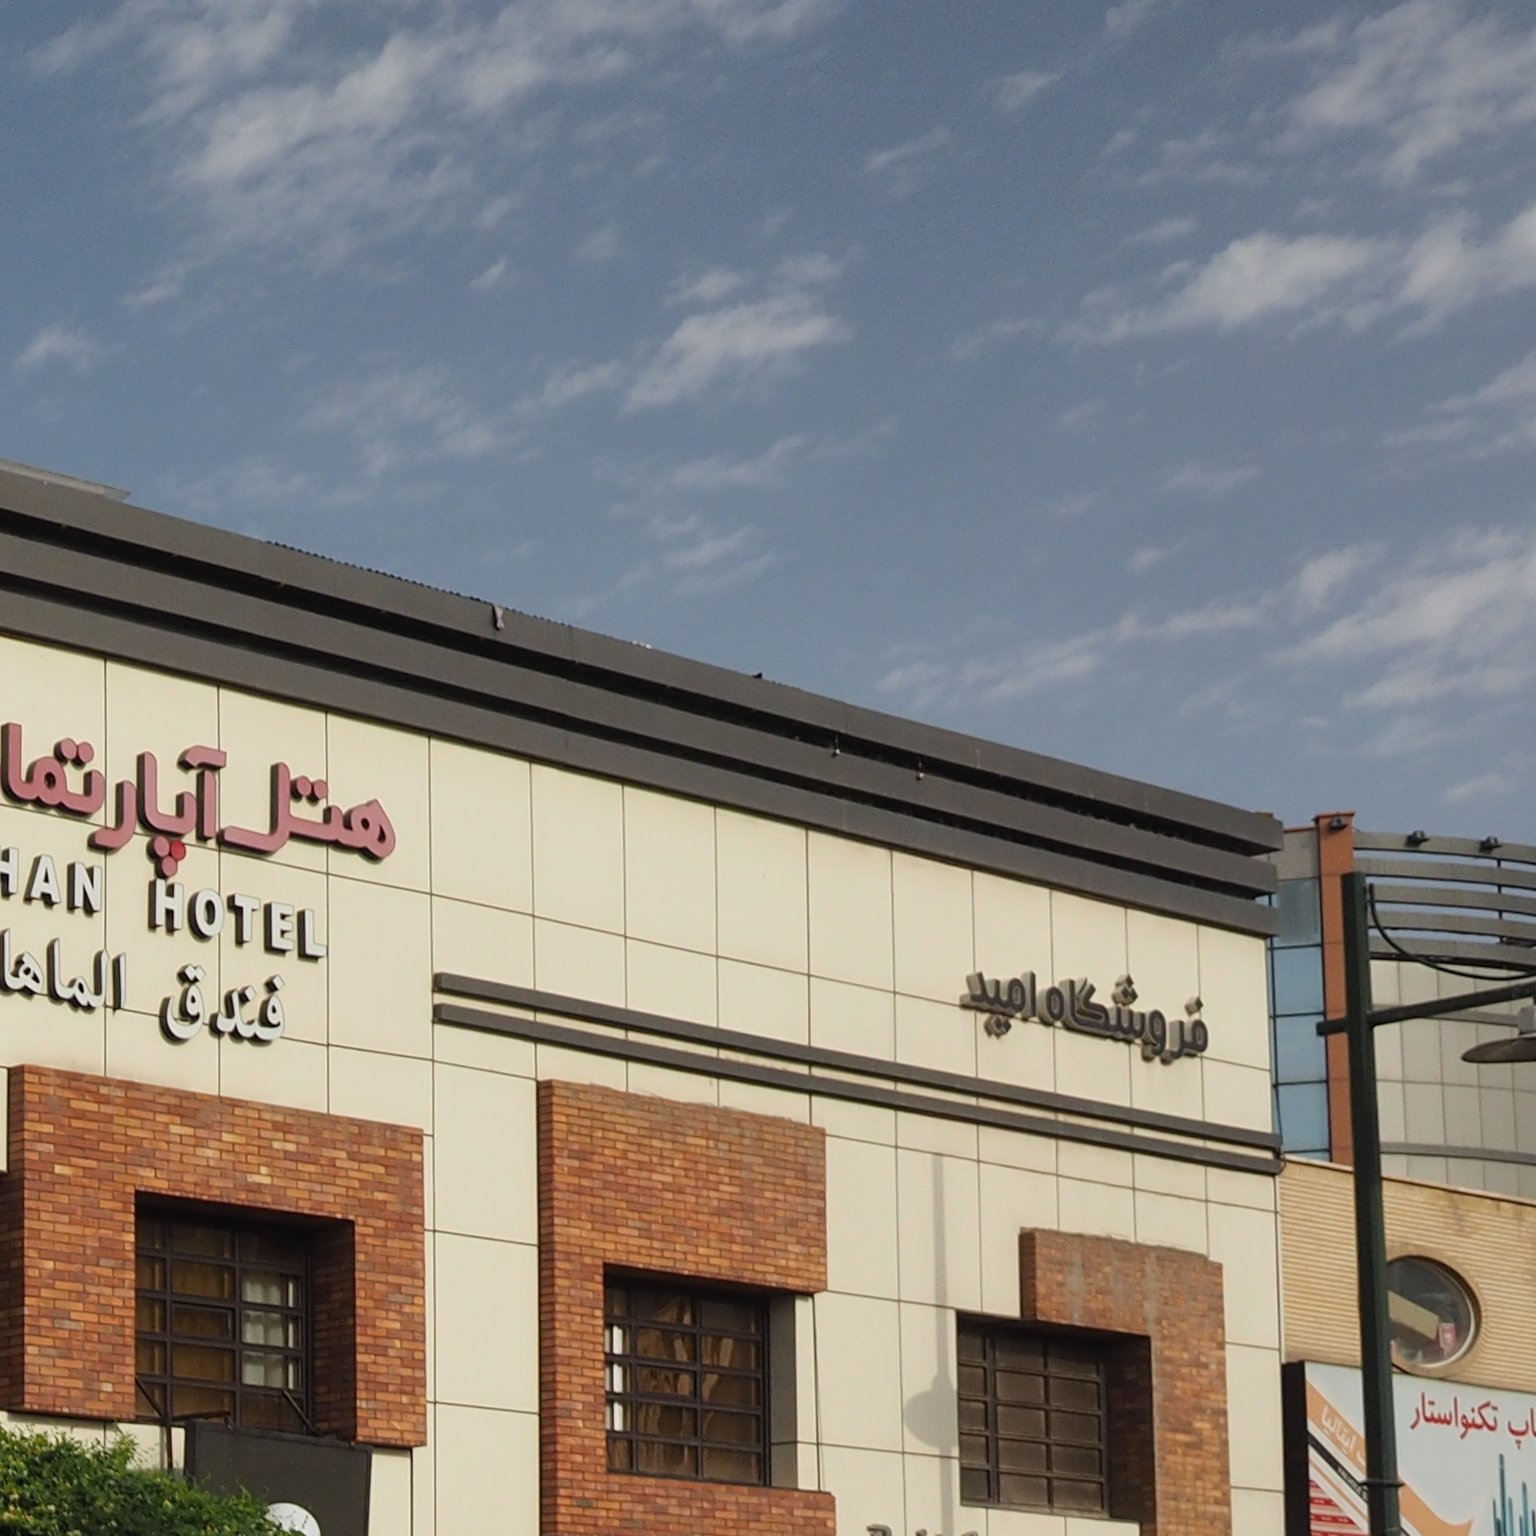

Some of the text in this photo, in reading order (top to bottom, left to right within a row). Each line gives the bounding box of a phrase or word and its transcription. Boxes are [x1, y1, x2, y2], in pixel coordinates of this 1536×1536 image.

[220, 762, 397, 860] هتل
[148, 879, 328, 960] HOTEL
[160, 963, 287, 1044] فندق
[959, 970, 1209, 1066] فروشگاه امید
